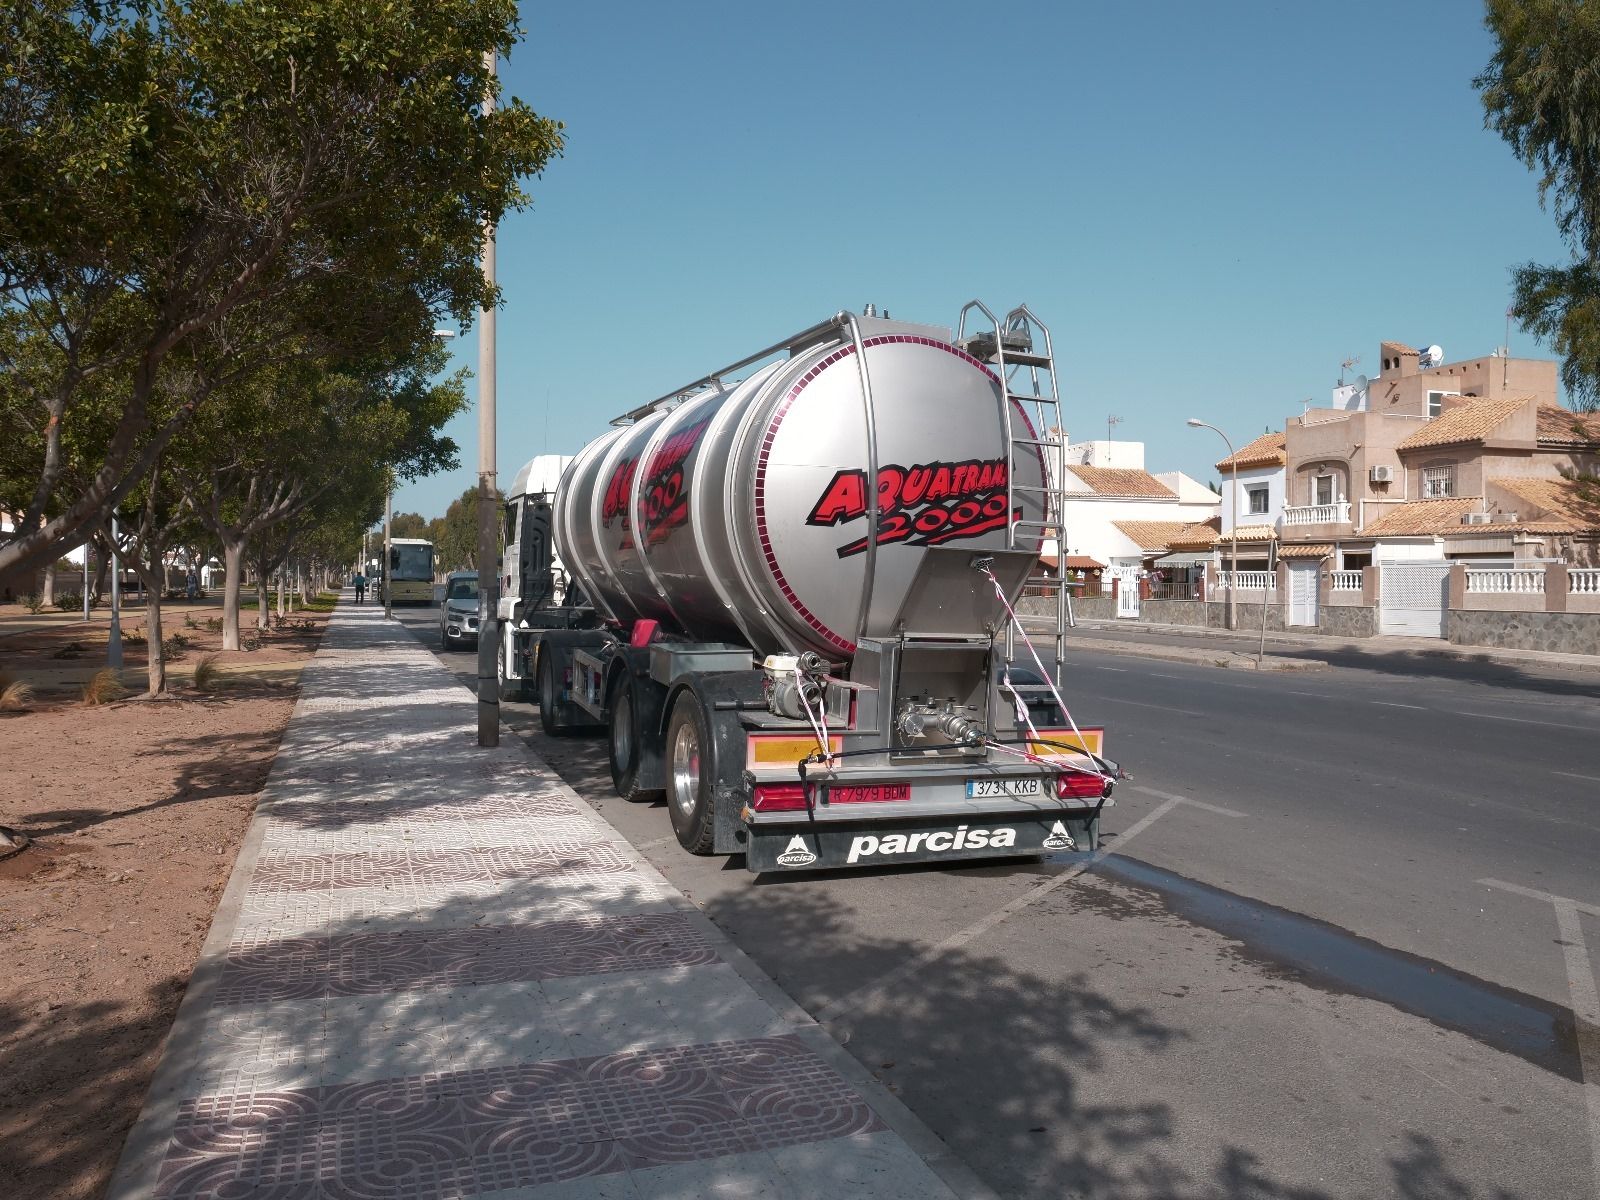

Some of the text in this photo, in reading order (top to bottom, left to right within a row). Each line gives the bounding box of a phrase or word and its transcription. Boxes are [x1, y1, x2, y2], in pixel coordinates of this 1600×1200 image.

[806, 458, 1013, 525] AQUATRAN
[839, 494, 1010, 554] 2000
[834, 788, 842, 801] R
[847, 787, 880, 801] 7979
[977, 780, 1038, 795] 3731 KKB
[846, 825, 1017, 864] parcisa
[777, 854, 814, 865] parcisa
